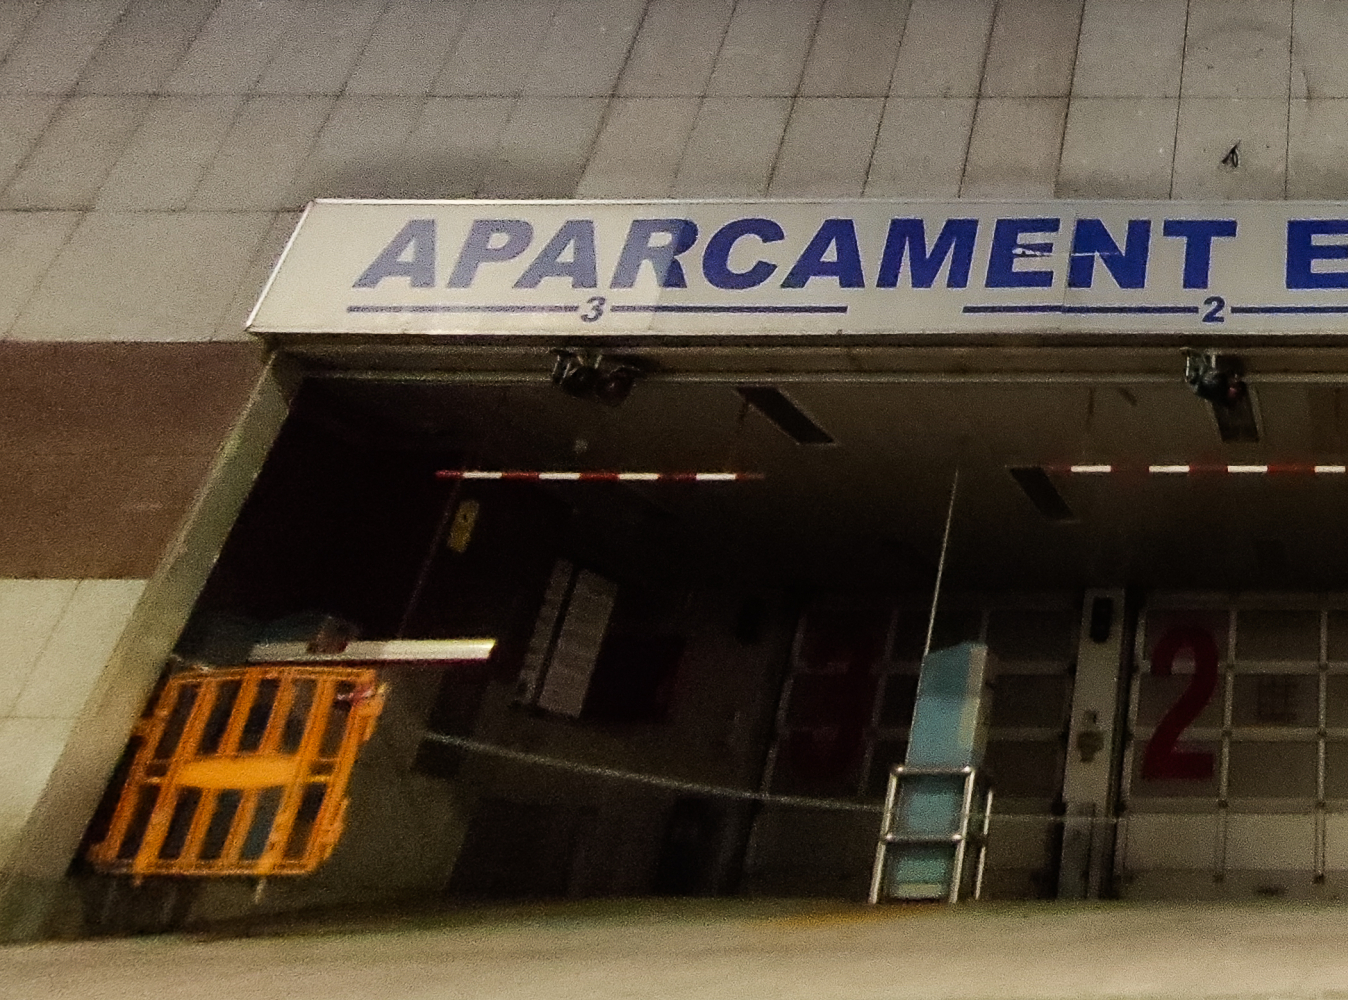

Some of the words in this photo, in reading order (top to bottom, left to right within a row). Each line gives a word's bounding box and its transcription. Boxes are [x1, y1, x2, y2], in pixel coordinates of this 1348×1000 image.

[352, 219, 1238, 289] APARCAMENT
[580, 296, 606, 322] 3
[1201, 296, 1226, 323] 2
[1142, 626, 1218, 779] 2
